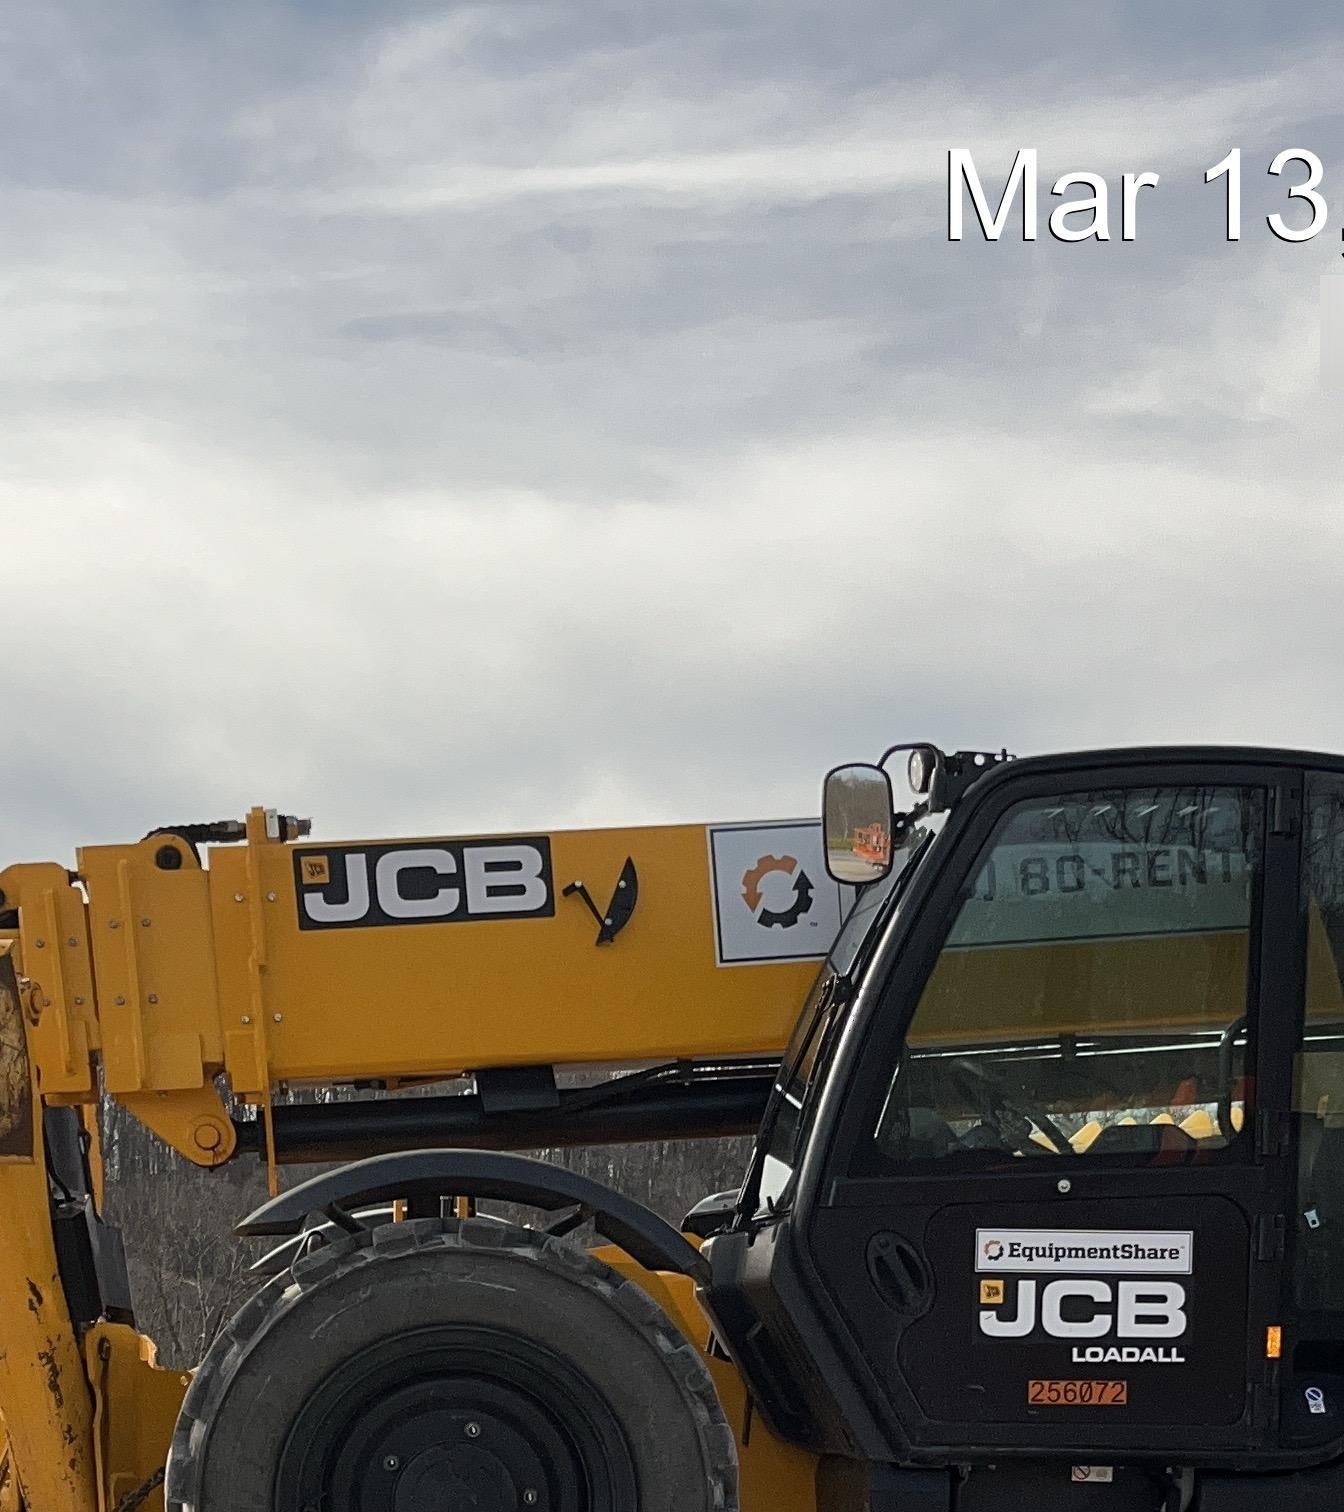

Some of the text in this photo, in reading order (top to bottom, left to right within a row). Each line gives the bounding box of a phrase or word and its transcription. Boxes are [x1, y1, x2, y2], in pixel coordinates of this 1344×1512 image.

[303, 844, 548, 923] JCB
[1007, 1242, 1181, 1263] EquipmentShare
[978, 1279, 1188, 1338] JCB
[1071, 1347, 1185, 1363] LOADALL
[1029, 1381, 1126, 1404] 256072
